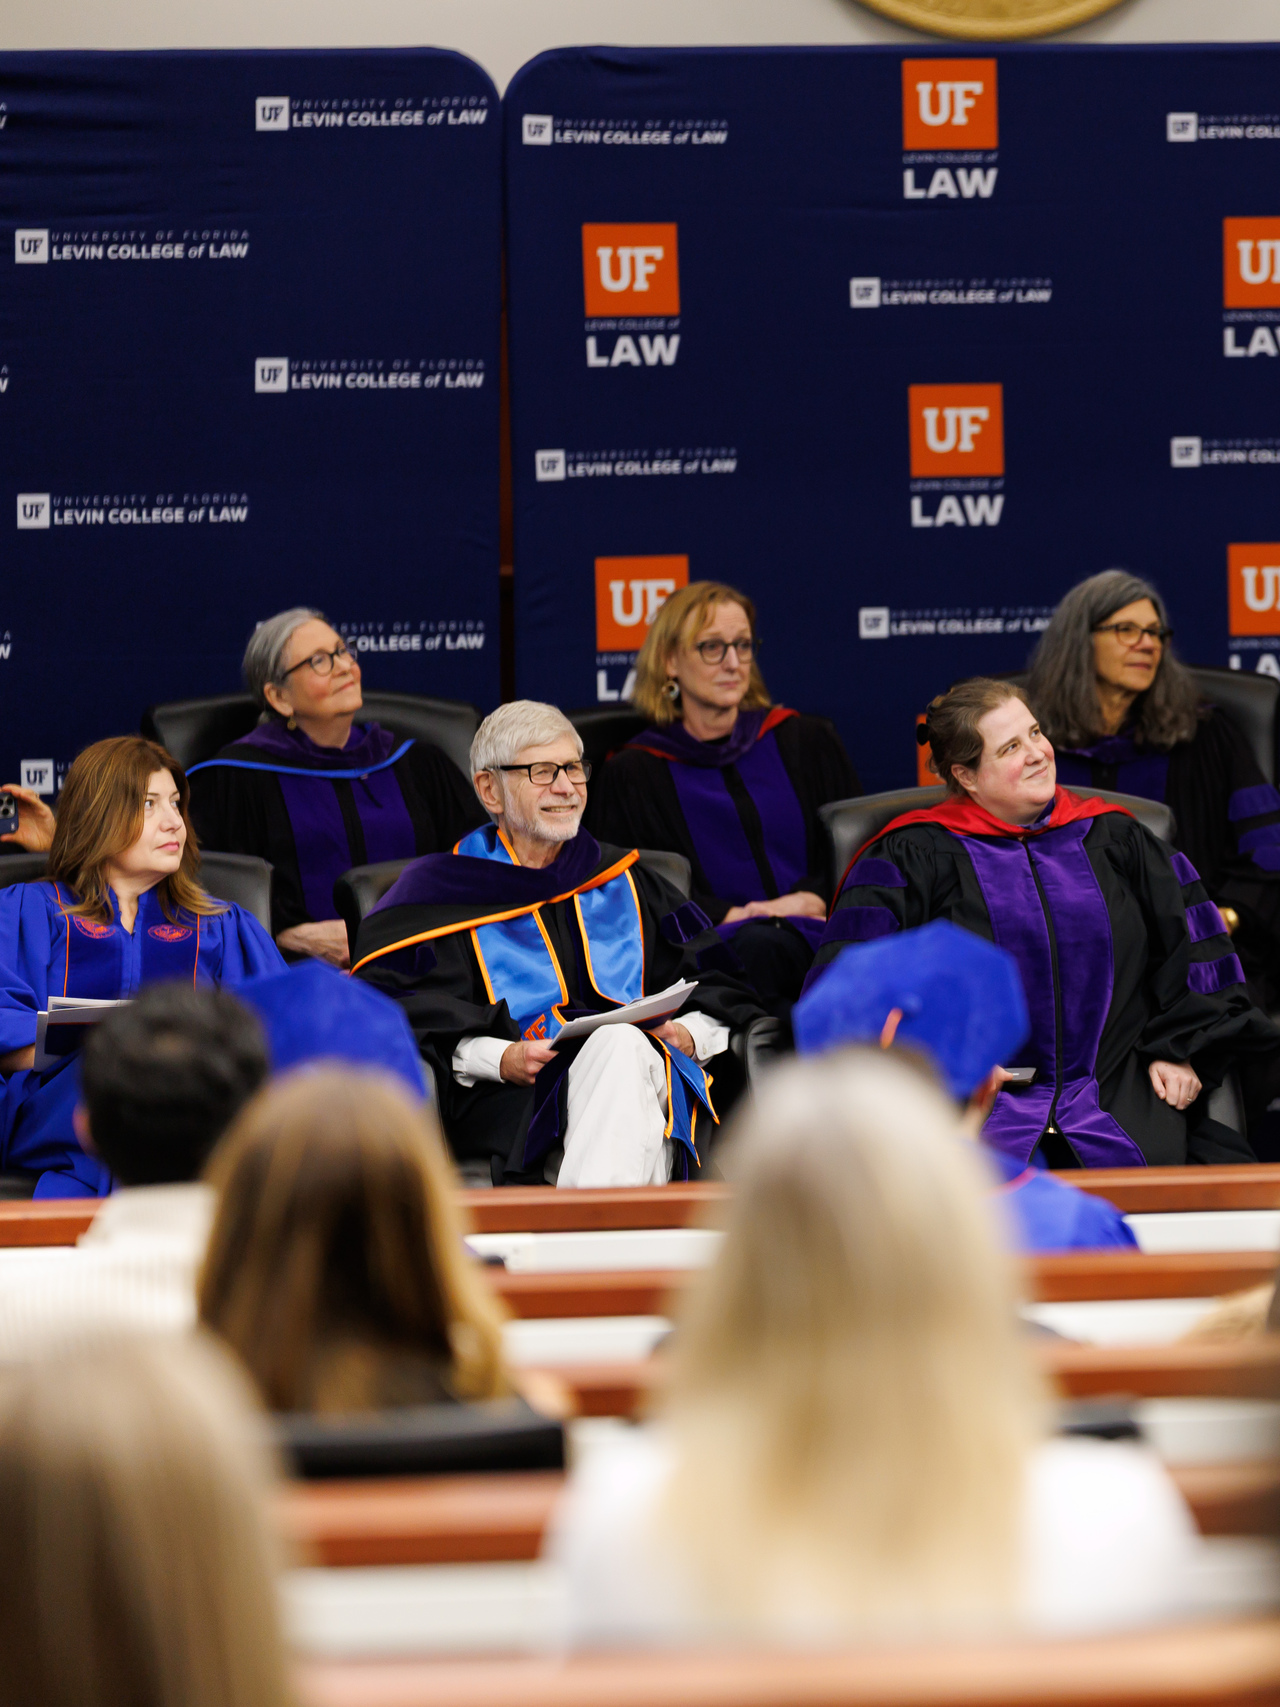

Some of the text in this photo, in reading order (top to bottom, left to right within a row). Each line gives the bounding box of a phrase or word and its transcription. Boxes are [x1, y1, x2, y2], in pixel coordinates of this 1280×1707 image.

[917, 82, 982, 125] UF
[292, 110, 488, 128] LEVIN COLLEGE of LAW
[554, 130, 601, 144] LEVIN
[602, 131, 672, 145] COLLEGE
[691, 131, 728, 145] LAW
[903, 168, 998, 199] LAW
[52, 230, 249, 242] UNIVERSITY OF FLORIDA
[52, 243, 249, 260] LEVIN COLLEGE of LAW
[597, 247, 663, 291] UF
[586, 335, 680, 367] LAW
[291, 373, 484, 389] LEVIN COLLEGE of LAW
[924, 408, 988, 452] UF
[567, 463, 613, 477] LEVIN
[614, 461, 682, 476] COLLEGE
[701, 461, 737, 474] LAW
[53, 493, 248, 506] UNIVERSITY OF FLORIDA
[53, 507, 248, 525] LEVIN COLLEGE of LAW
[911, 495, 1004, 527] LAW
[609, 580, 675, 626] UF
[424, 636, 442, 650] of
[445, 633, 485, 650] LAW
